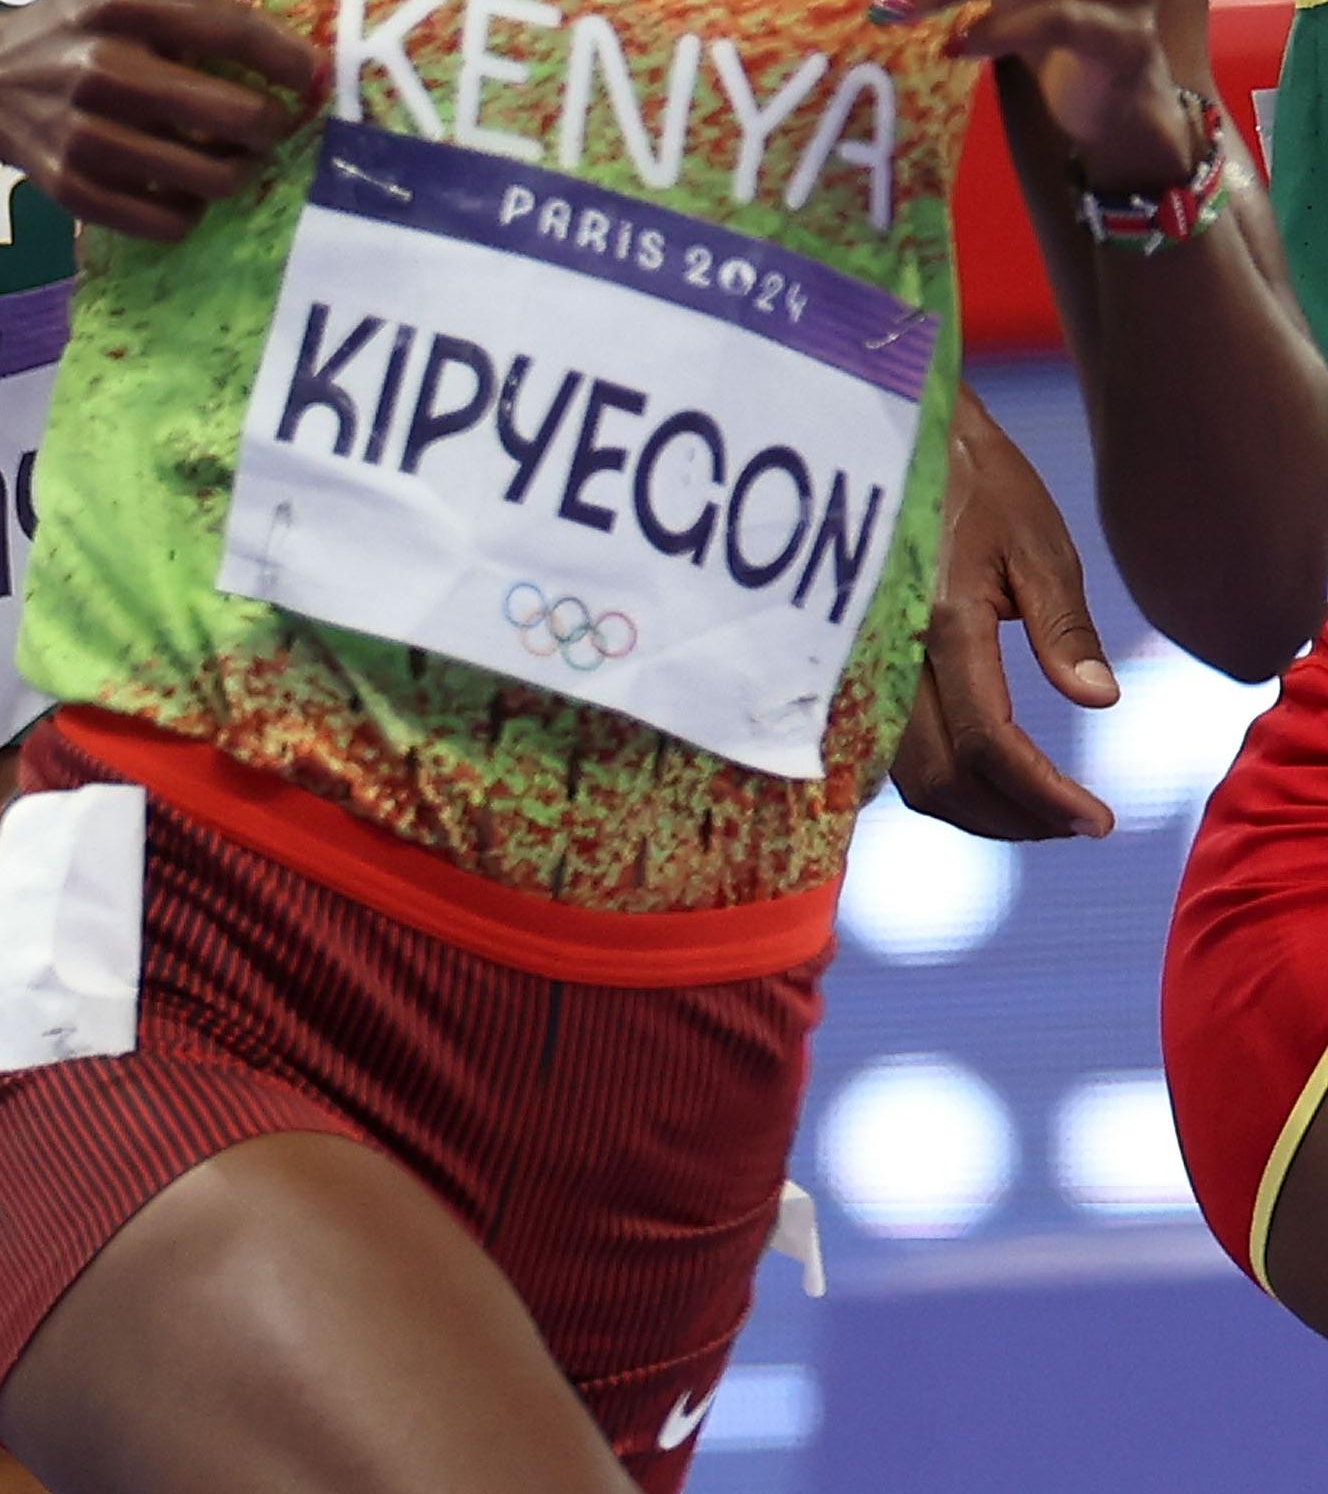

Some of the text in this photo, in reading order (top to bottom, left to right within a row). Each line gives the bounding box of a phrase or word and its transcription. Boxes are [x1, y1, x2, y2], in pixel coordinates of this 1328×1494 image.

[498, 185, 810, 324] PARIS 2024
[275, 302, 885, 624] KIPYEGON
